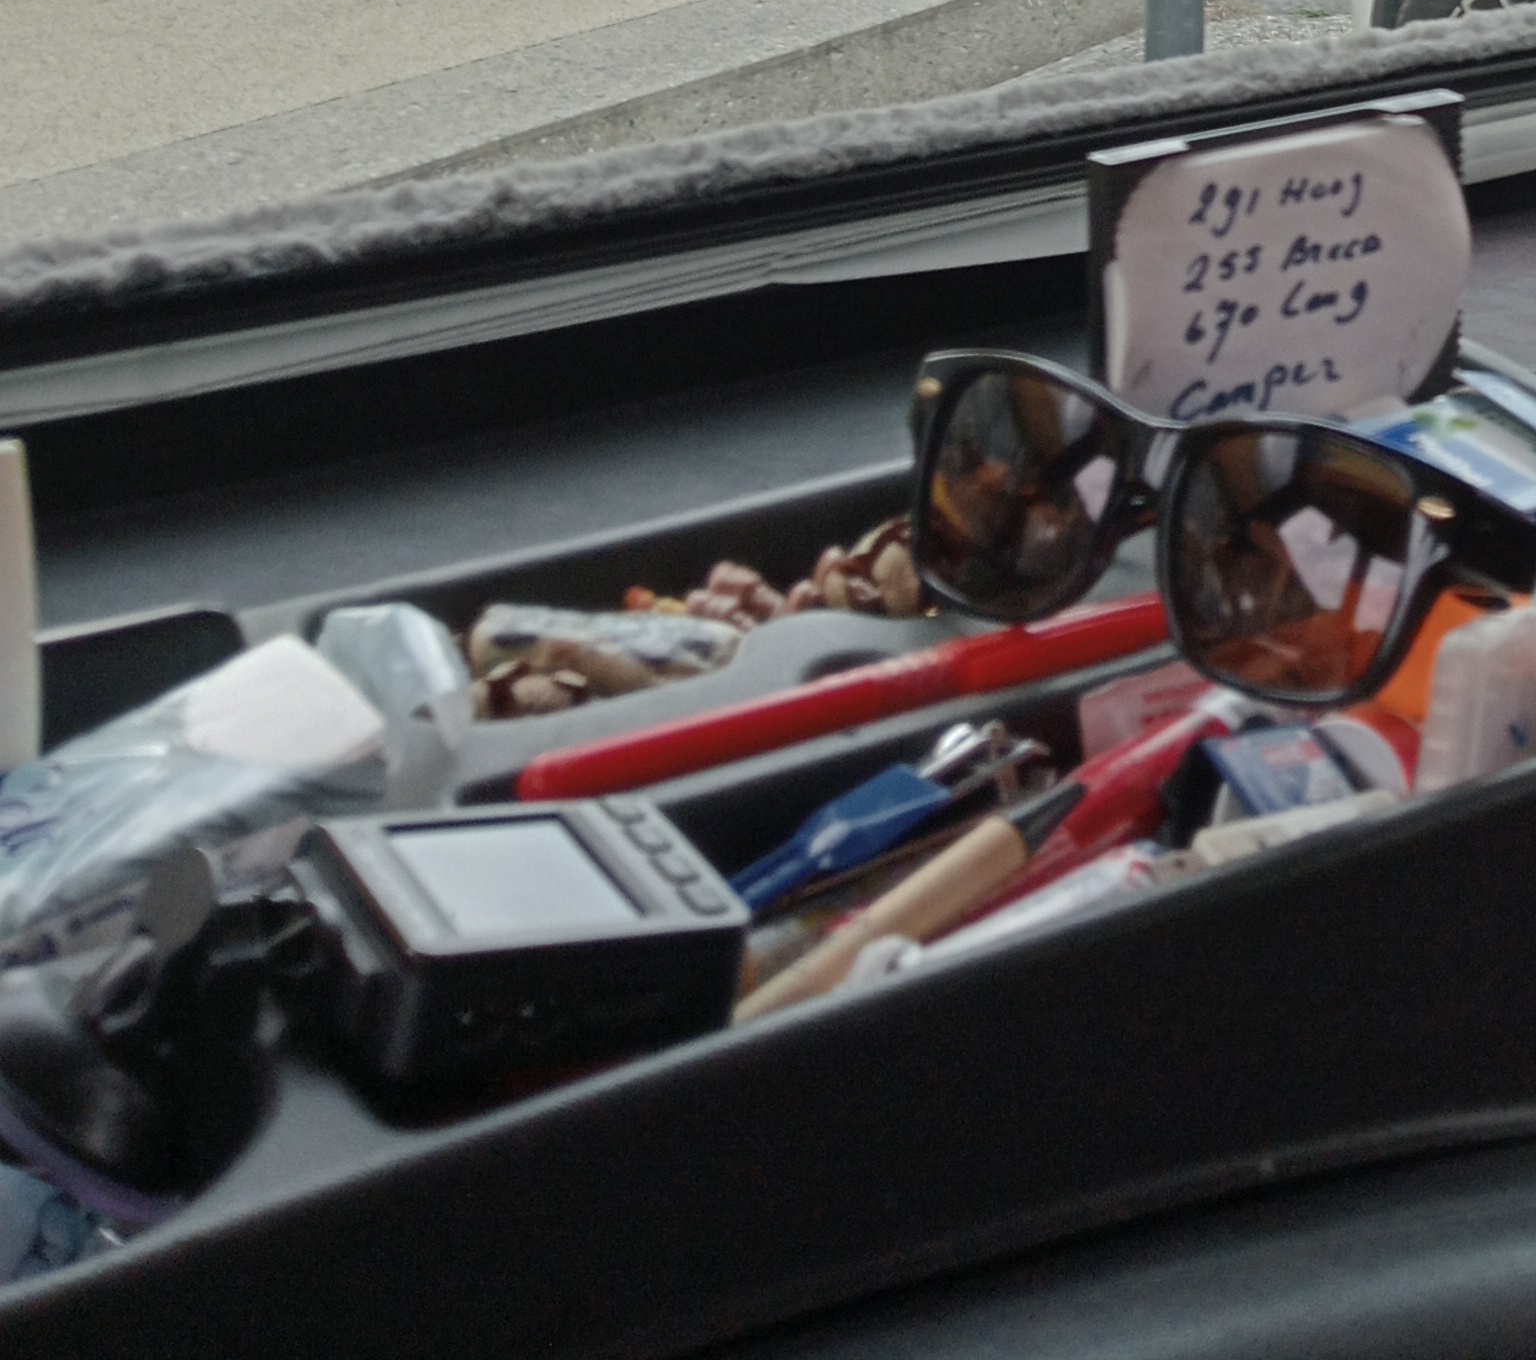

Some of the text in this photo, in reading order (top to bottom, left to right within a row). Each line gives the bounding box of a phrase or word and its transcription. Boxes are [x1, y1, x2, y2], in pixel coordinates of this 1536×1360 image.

[1188, 182, 1260, 238] 291
[1182, 243, 1263, 293] 255
[1184, 298, 1259, 365] 670
[1171, 356, 1341, 421] Camper
